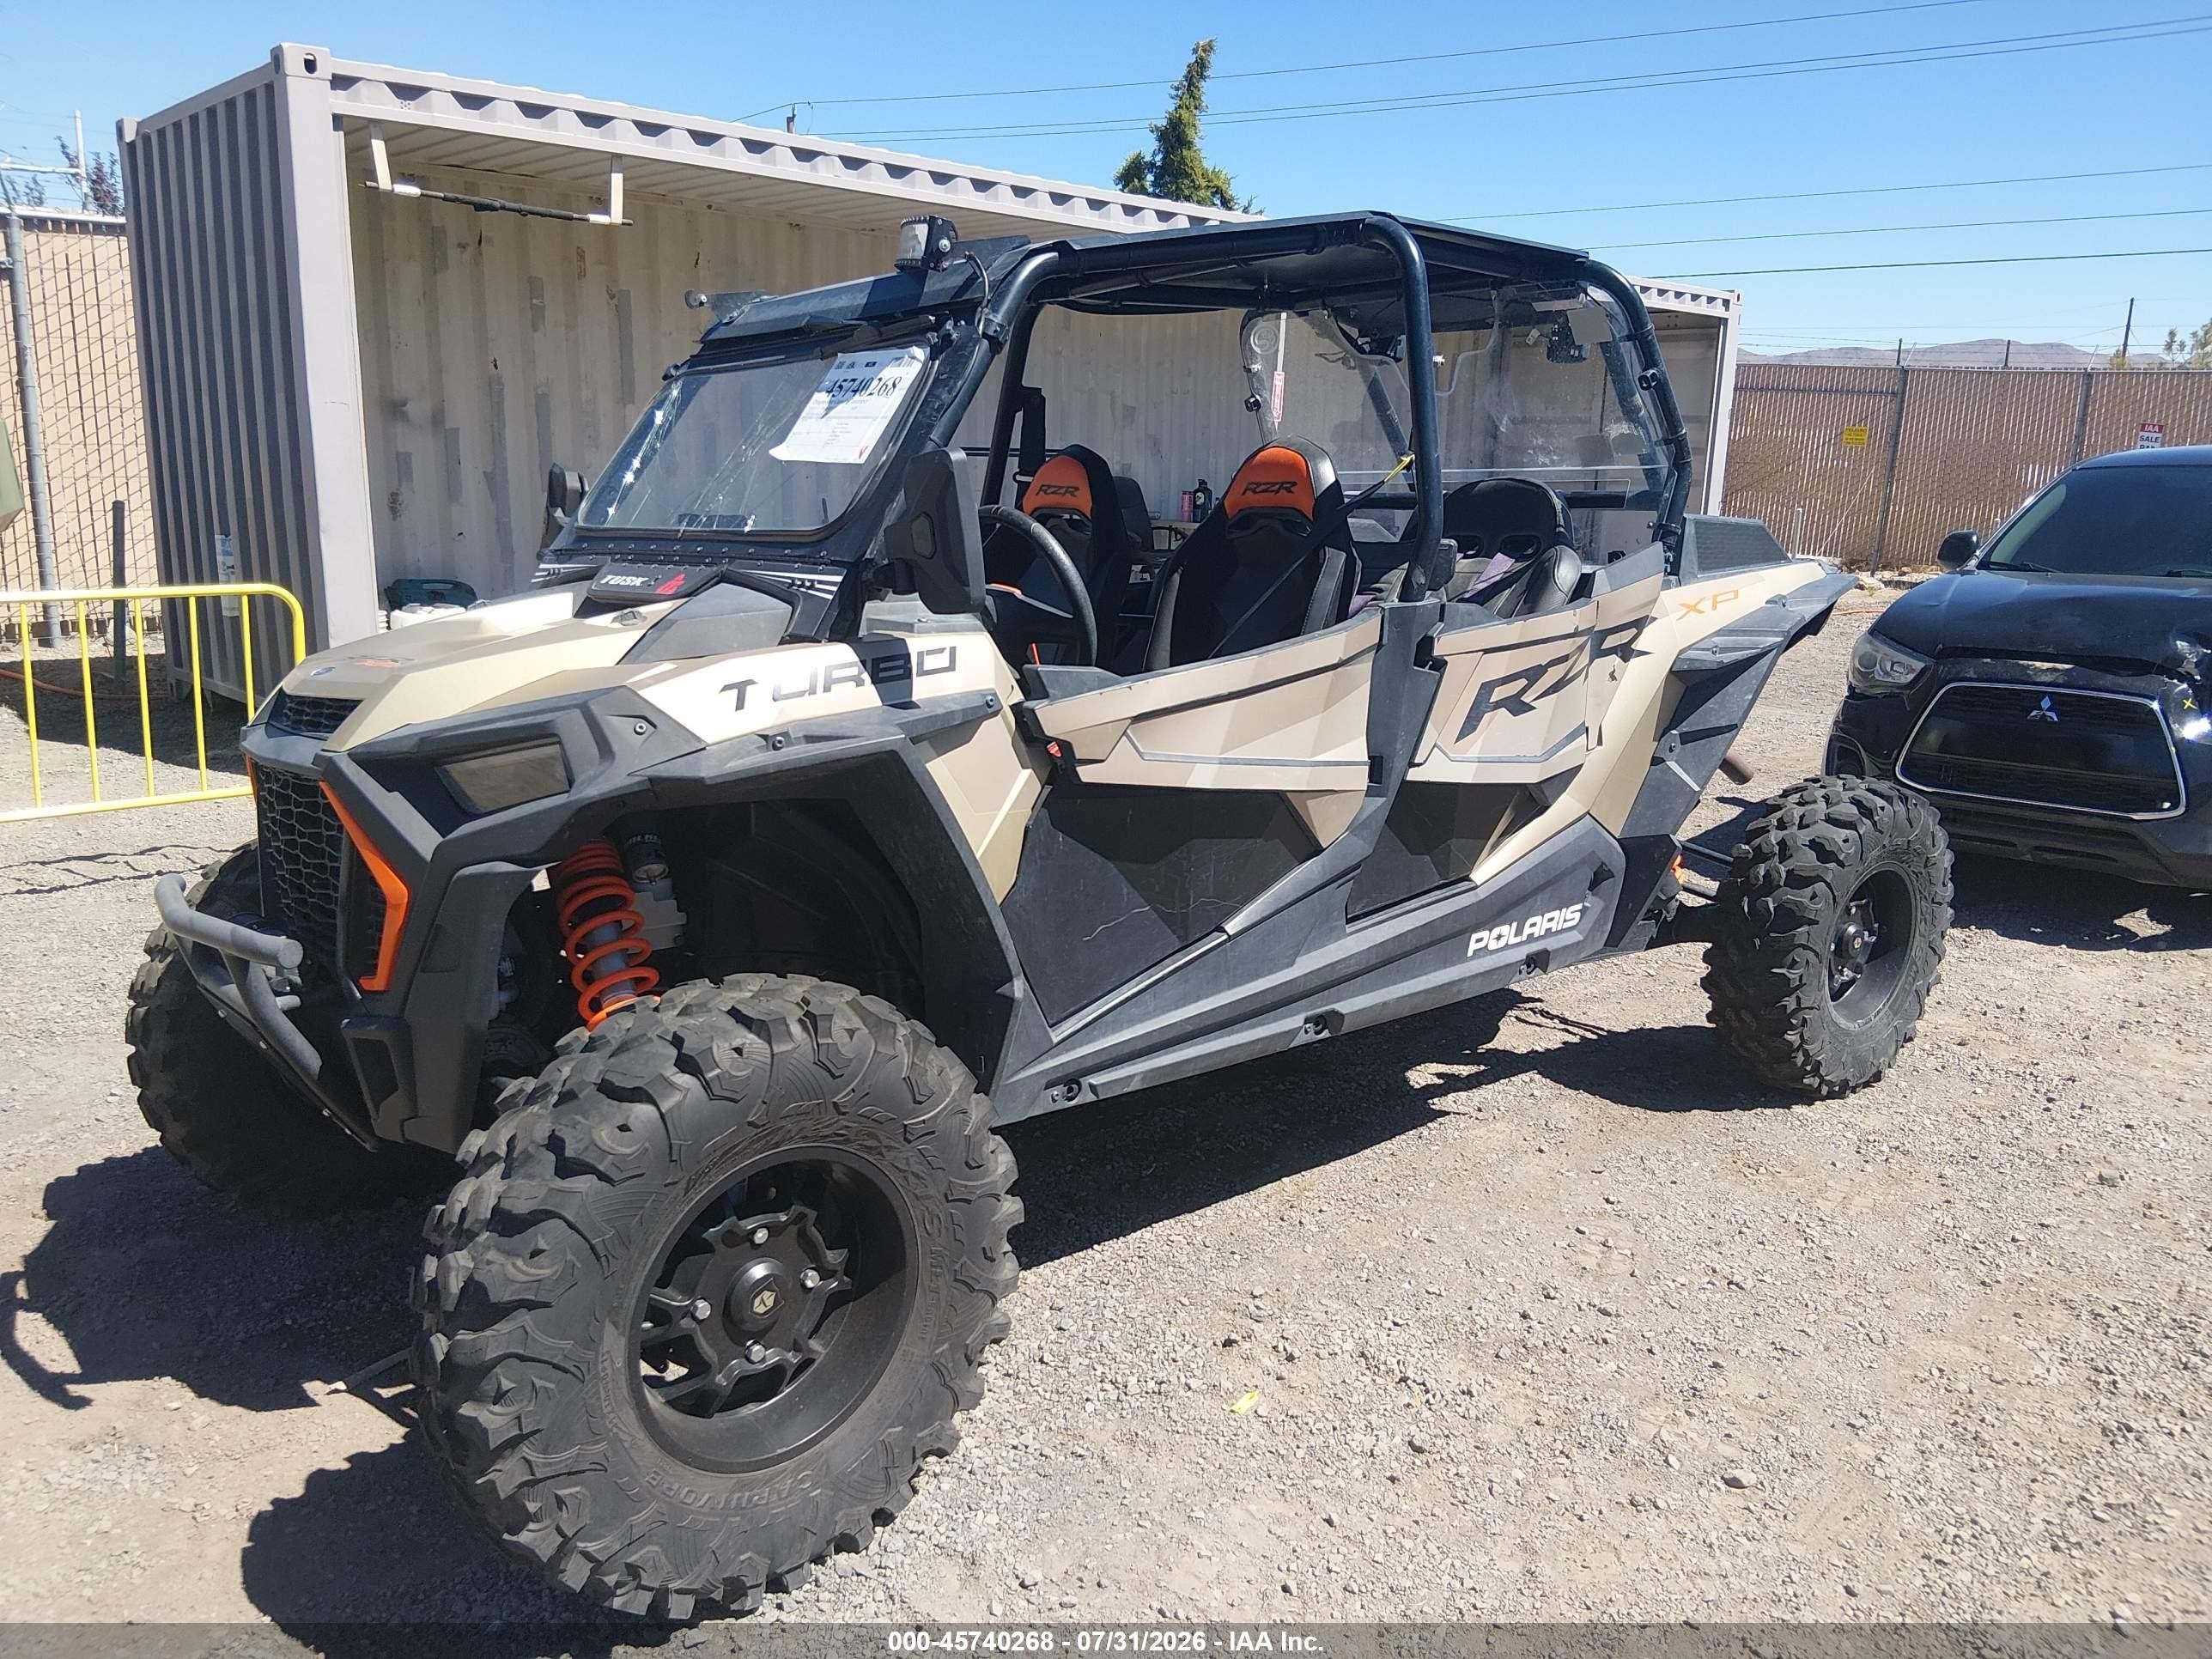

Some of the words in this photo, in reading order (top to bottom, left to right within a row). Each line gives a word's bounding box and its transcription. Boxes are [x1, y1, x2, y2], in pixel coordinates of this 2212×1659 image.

[2139, 434, 2160, 443] SALE
[1035, 483, 1079, 497] RZR
[1241, 481, 1299, 495] RZR
[600, 574, 649, 586] TUSK
[1675, 589, 1739, 621] XP
[718, 646, 957, 712] TURBO
[1454, 614, 1659, 745] RZR
[1467, 902, 1583, 958] POLARIS
